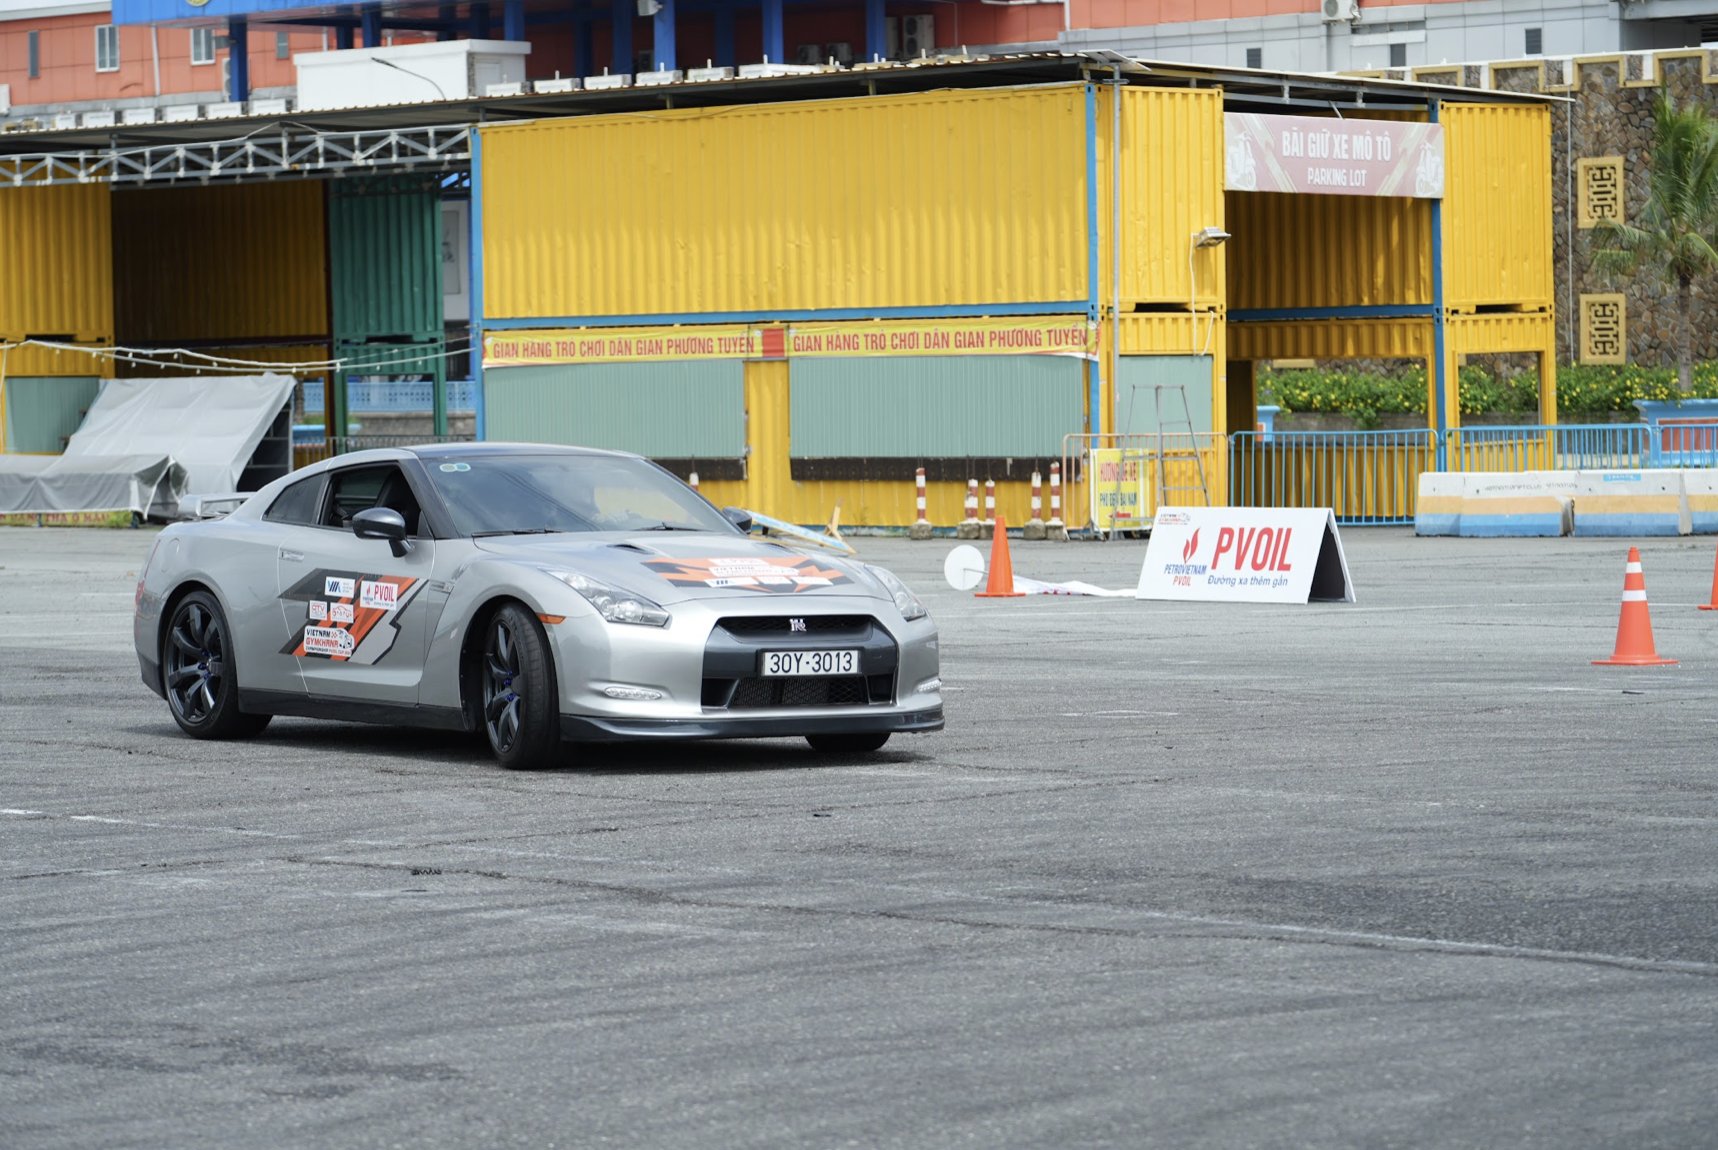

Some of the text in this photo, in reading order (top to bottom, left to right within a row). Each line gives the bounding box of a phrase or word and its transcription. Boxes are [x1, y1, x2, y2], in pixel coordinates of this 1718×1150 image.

[1282, 127, 1391, 161] BÃI GIỮ XE MÔ TÔ
[1308, 168, 1367, 187] PARKING LOT
[493, 341, 518, 358] GIAN
[556, 338, 576, 357] TRÒ
[580, 338, 605, 356] CHƠI
[609, 337, 632, 356] DÂN
[636, 338, 663, 355] GIAN
[667, 337, 713, 355] PHƯƠNG
[793, 334, 822, 352] GIAN
[826, 331, 859, 351] HÀNG
[864, 330, 886, 350] TRÒ
[891, 331, 919, 350] CHƠI
[924, 328, 949, 349] DÂN
[954, 331, 984, 348] GIAN
[989, 328, 1042, 348] PHƯƠNG
[1211, 527, 1292, 571] PVOIL
[1164, 564, 1207, 575] PETROVIETNAM
[1173, 576, 1191, 587] PVOIL
[1208, 575, 1236, 587] Đường
[1238, 577, 1248, 585] xa
[1250, 575, 1270, 586] thêm
[374, 584, 394, 602] PVOIL
[770, 652, 852, 673] 30Y-3013
